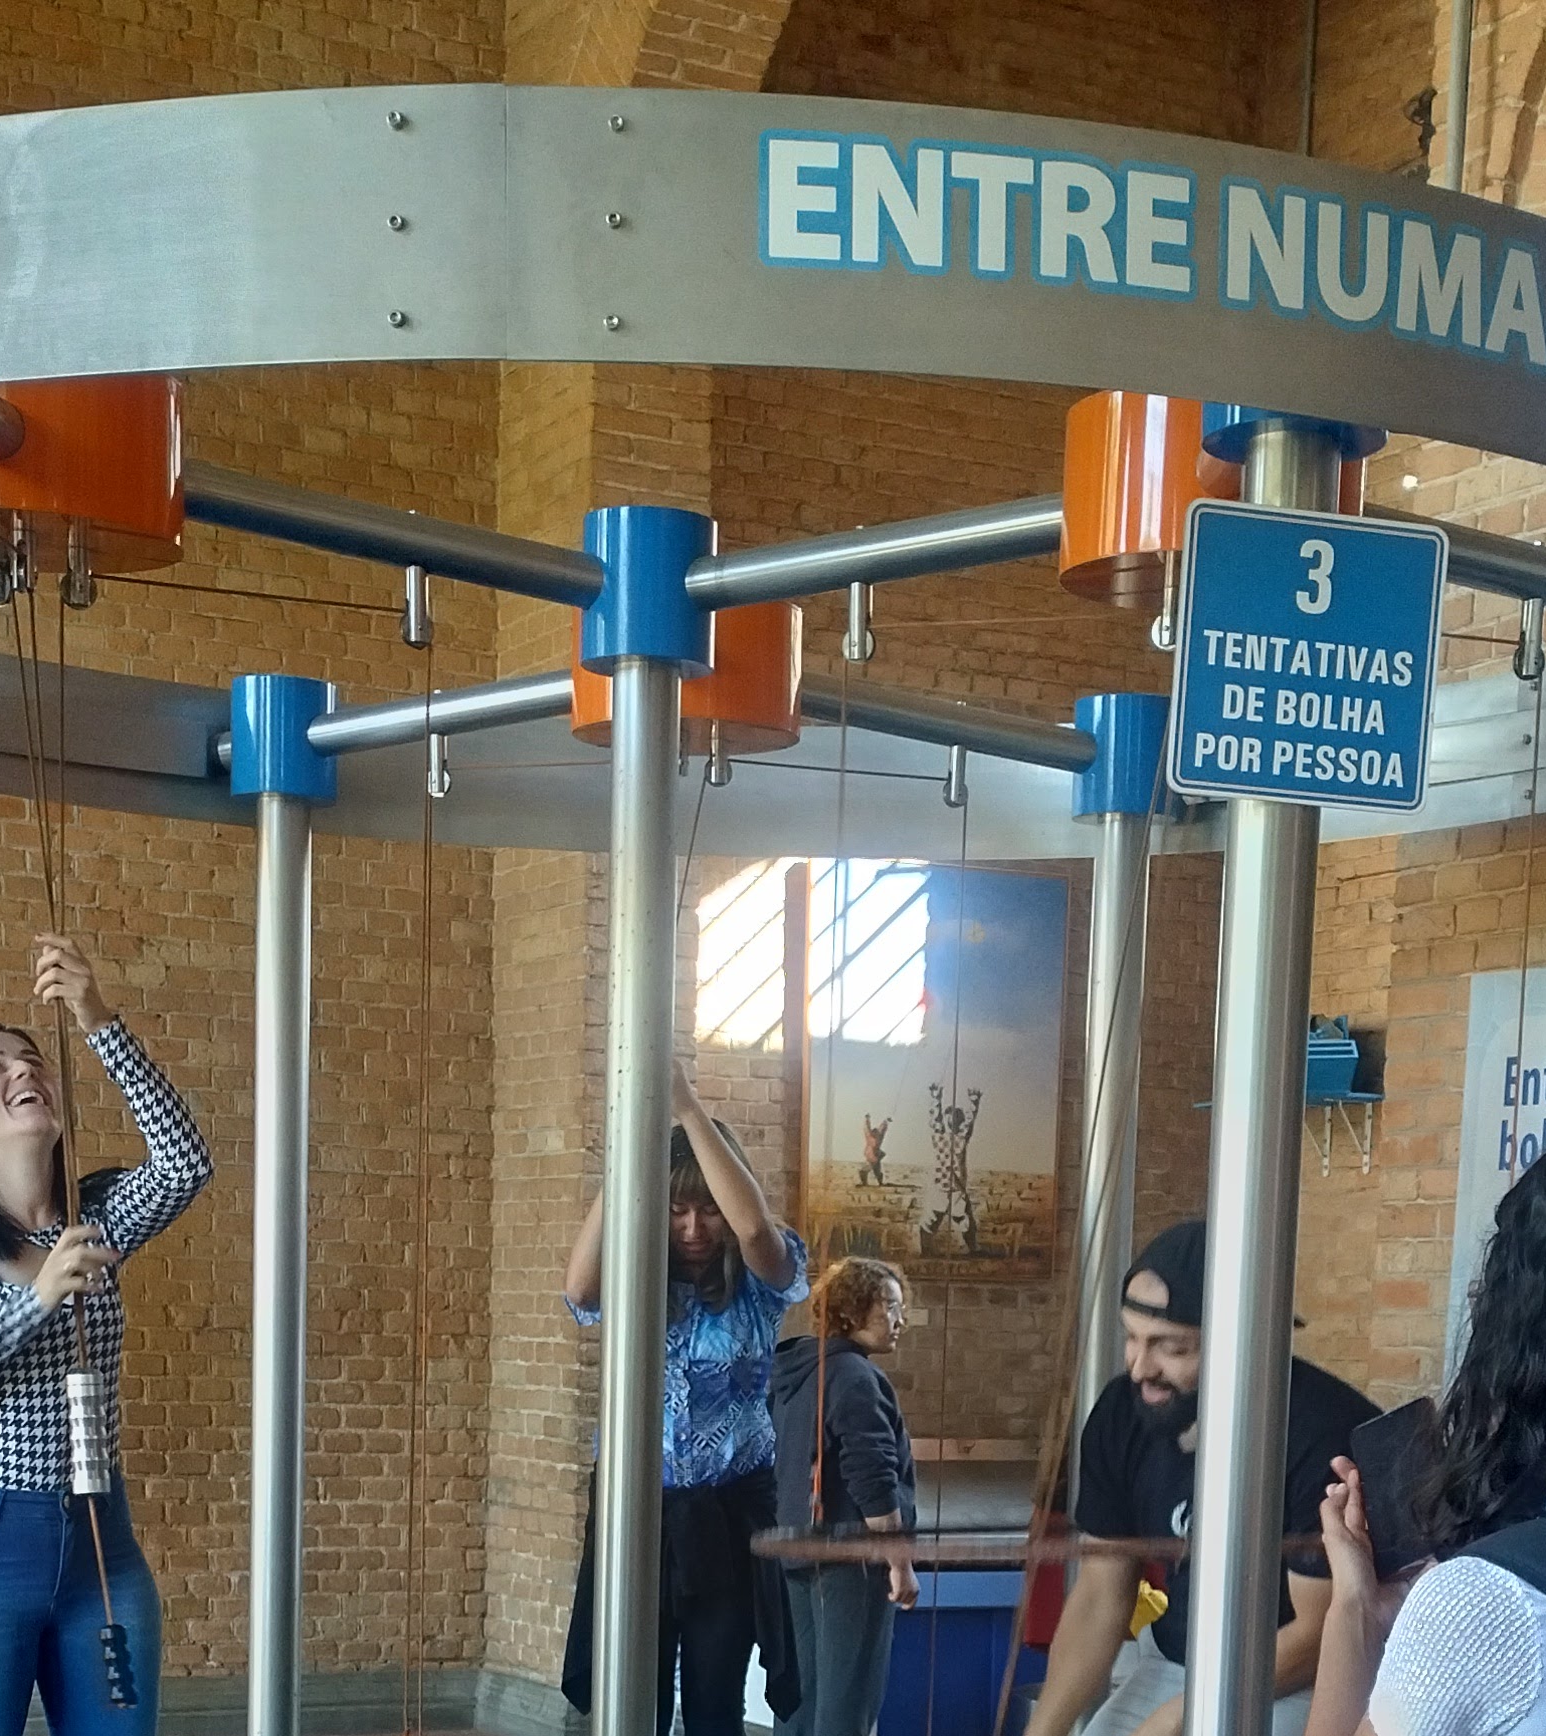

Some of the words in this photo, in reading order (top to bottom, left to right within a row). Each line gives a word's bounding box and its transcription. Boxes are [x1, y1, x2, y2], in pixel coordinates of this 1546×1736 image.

[768, 138, 1191, 293] ENTRE
[1296, 539, 1335, 615] 3
[1203, 629, 1414, 687] TENTATIVAS
[1222, 684, 1266, 722] DE
[1275, 689, 1386, 736] BOLHA
[1194, 732, 1262, 774] POR
[1272, 740, 1405, 789] PESSOA
